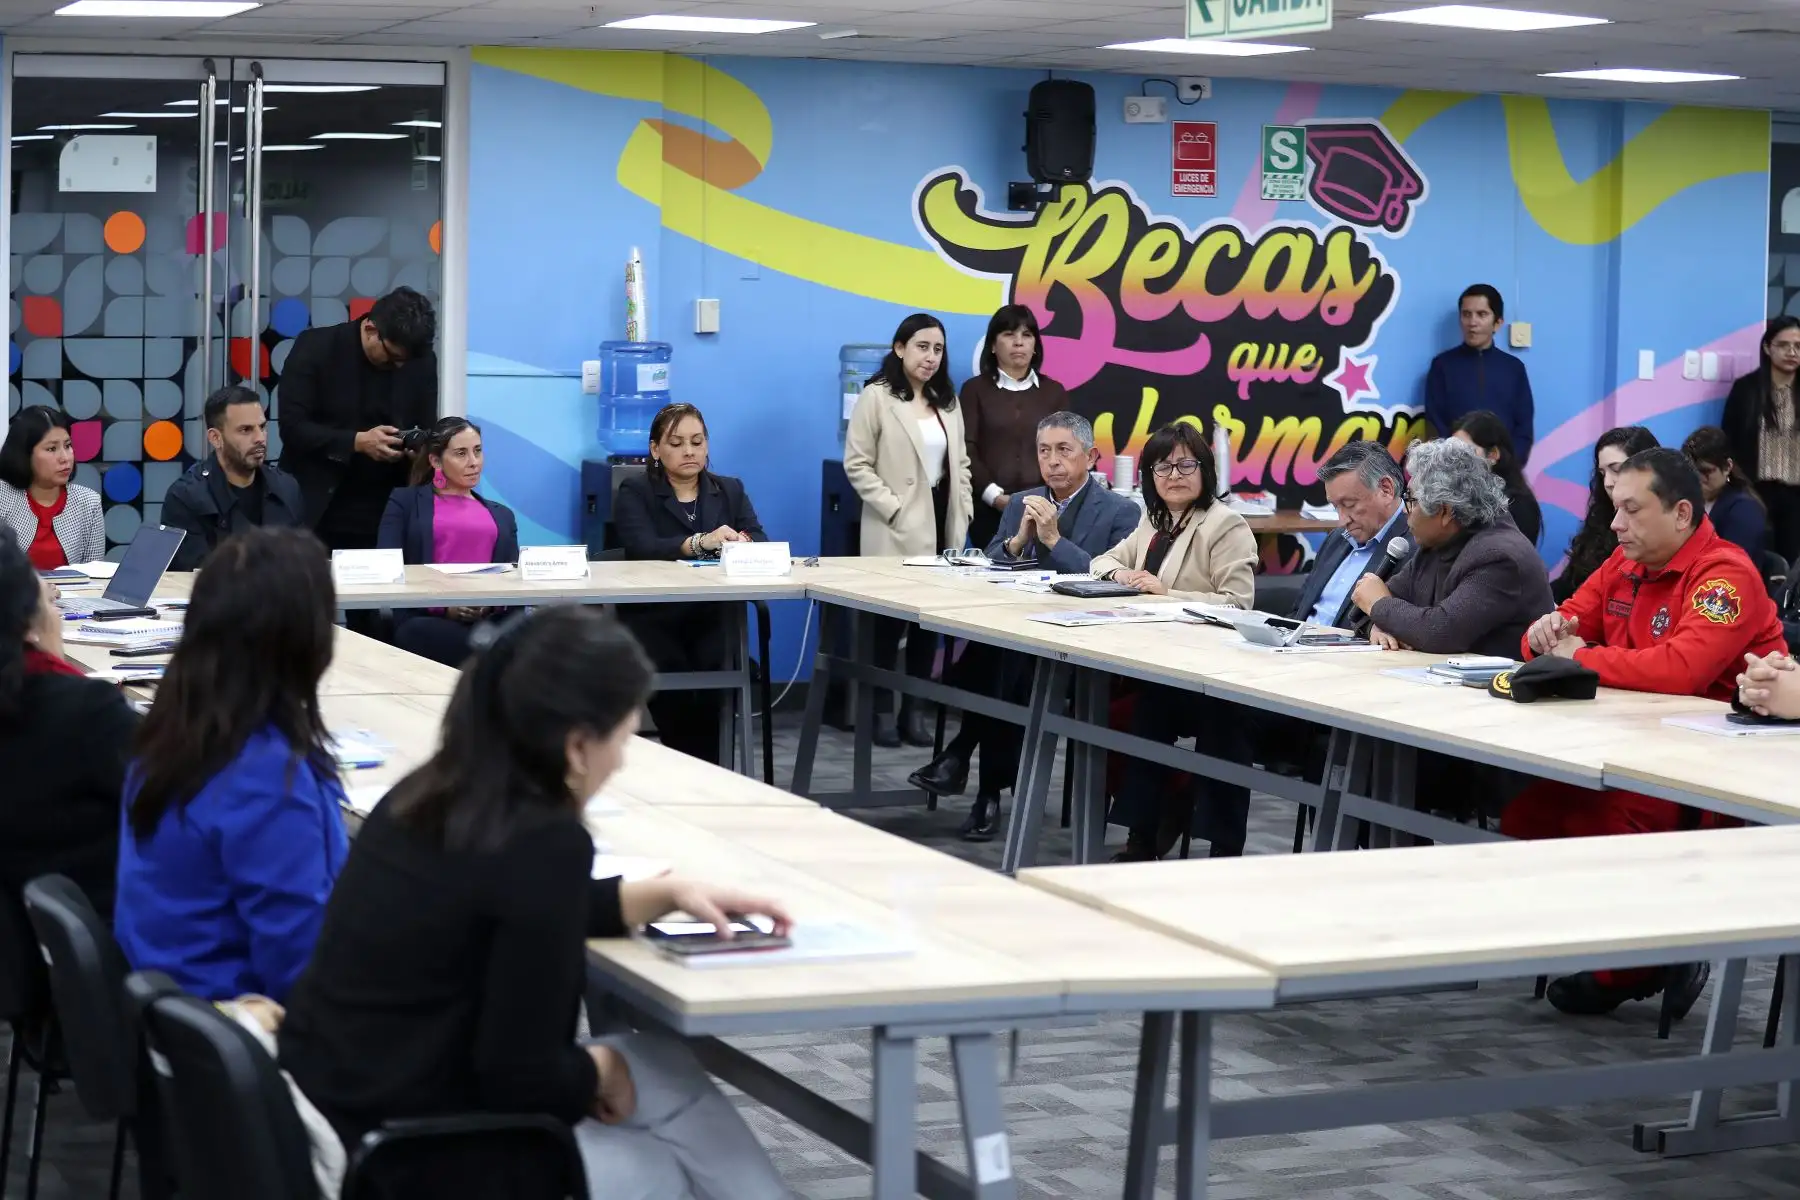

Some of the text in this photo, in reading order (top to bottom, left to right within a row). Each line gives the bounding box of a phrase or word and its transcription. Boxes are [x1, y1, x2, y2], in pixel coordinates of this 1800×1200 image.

[1270, 130, 1298, 170] S
[1174, 184, 1215, 194] EMERGENCIA
[1179, 173, 1210, 183] LUCES DE
[1226, 341, 1323, 400] que
